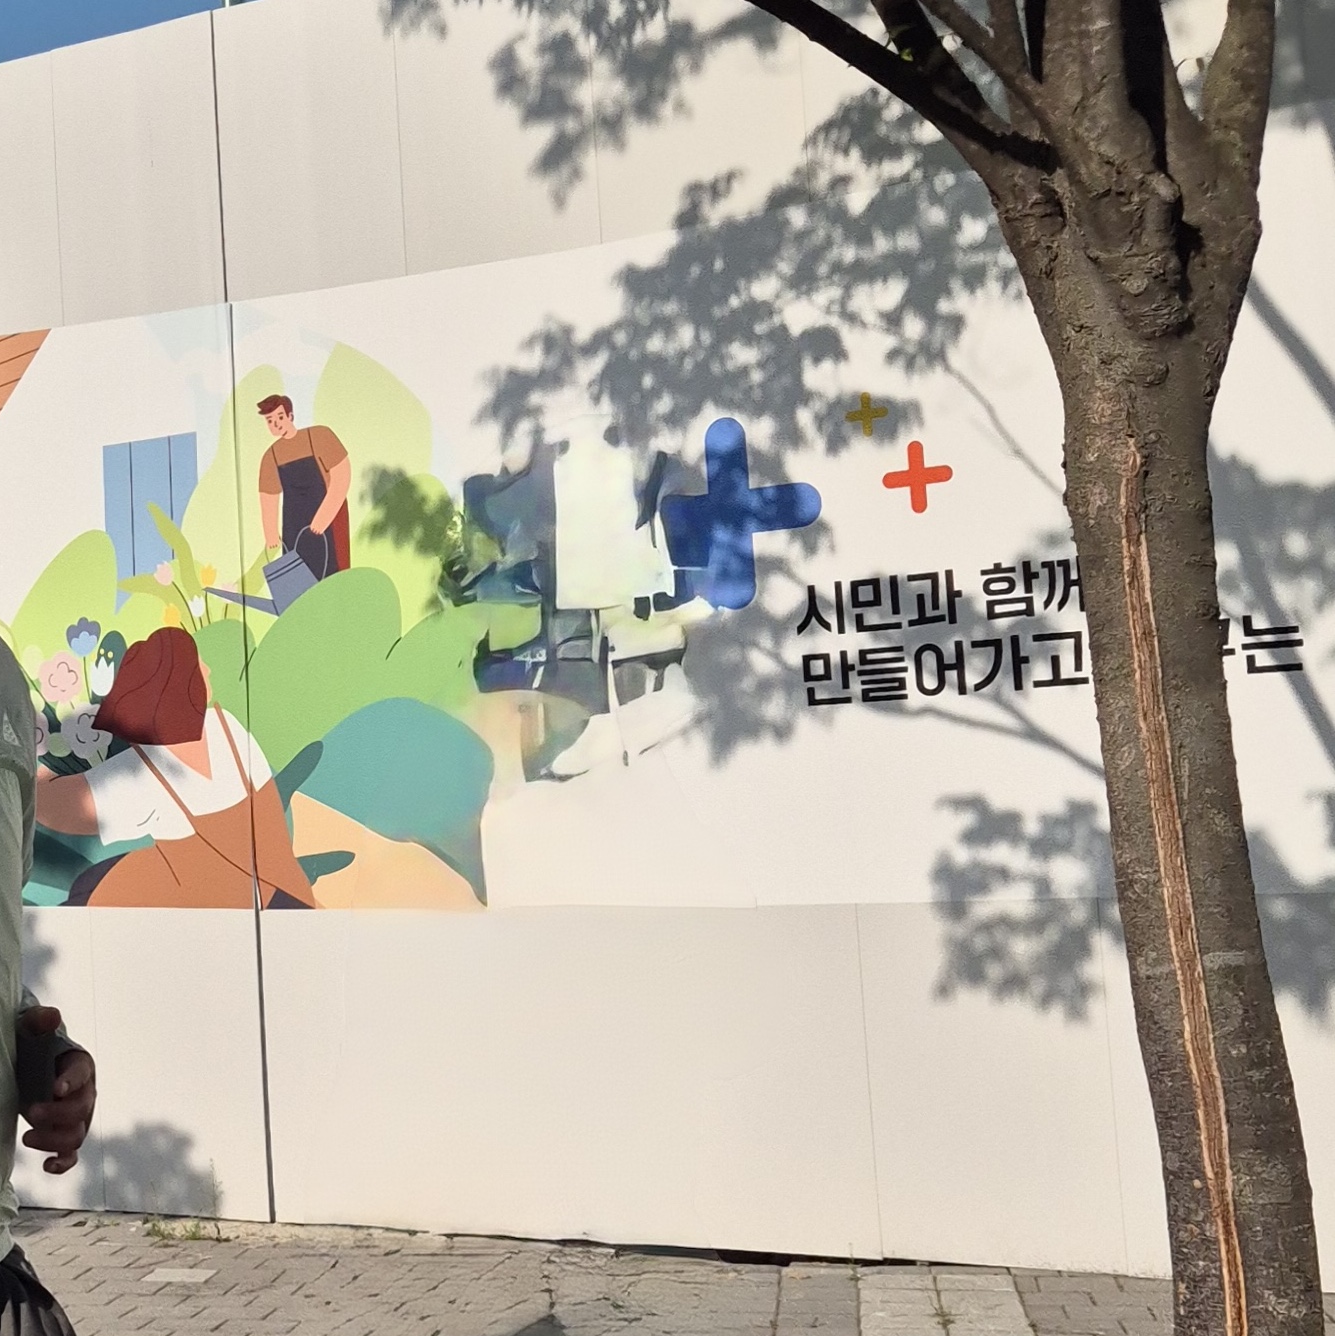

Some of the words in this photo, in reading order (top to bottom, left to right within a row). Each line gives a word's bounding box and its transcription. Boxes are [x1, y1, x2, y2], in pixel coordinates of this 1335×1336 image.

[796, 568, 963, 636] 시민과
[802, 630, 1090, 706] 만들어가고
[1218, 614, 1305, 675] 는
